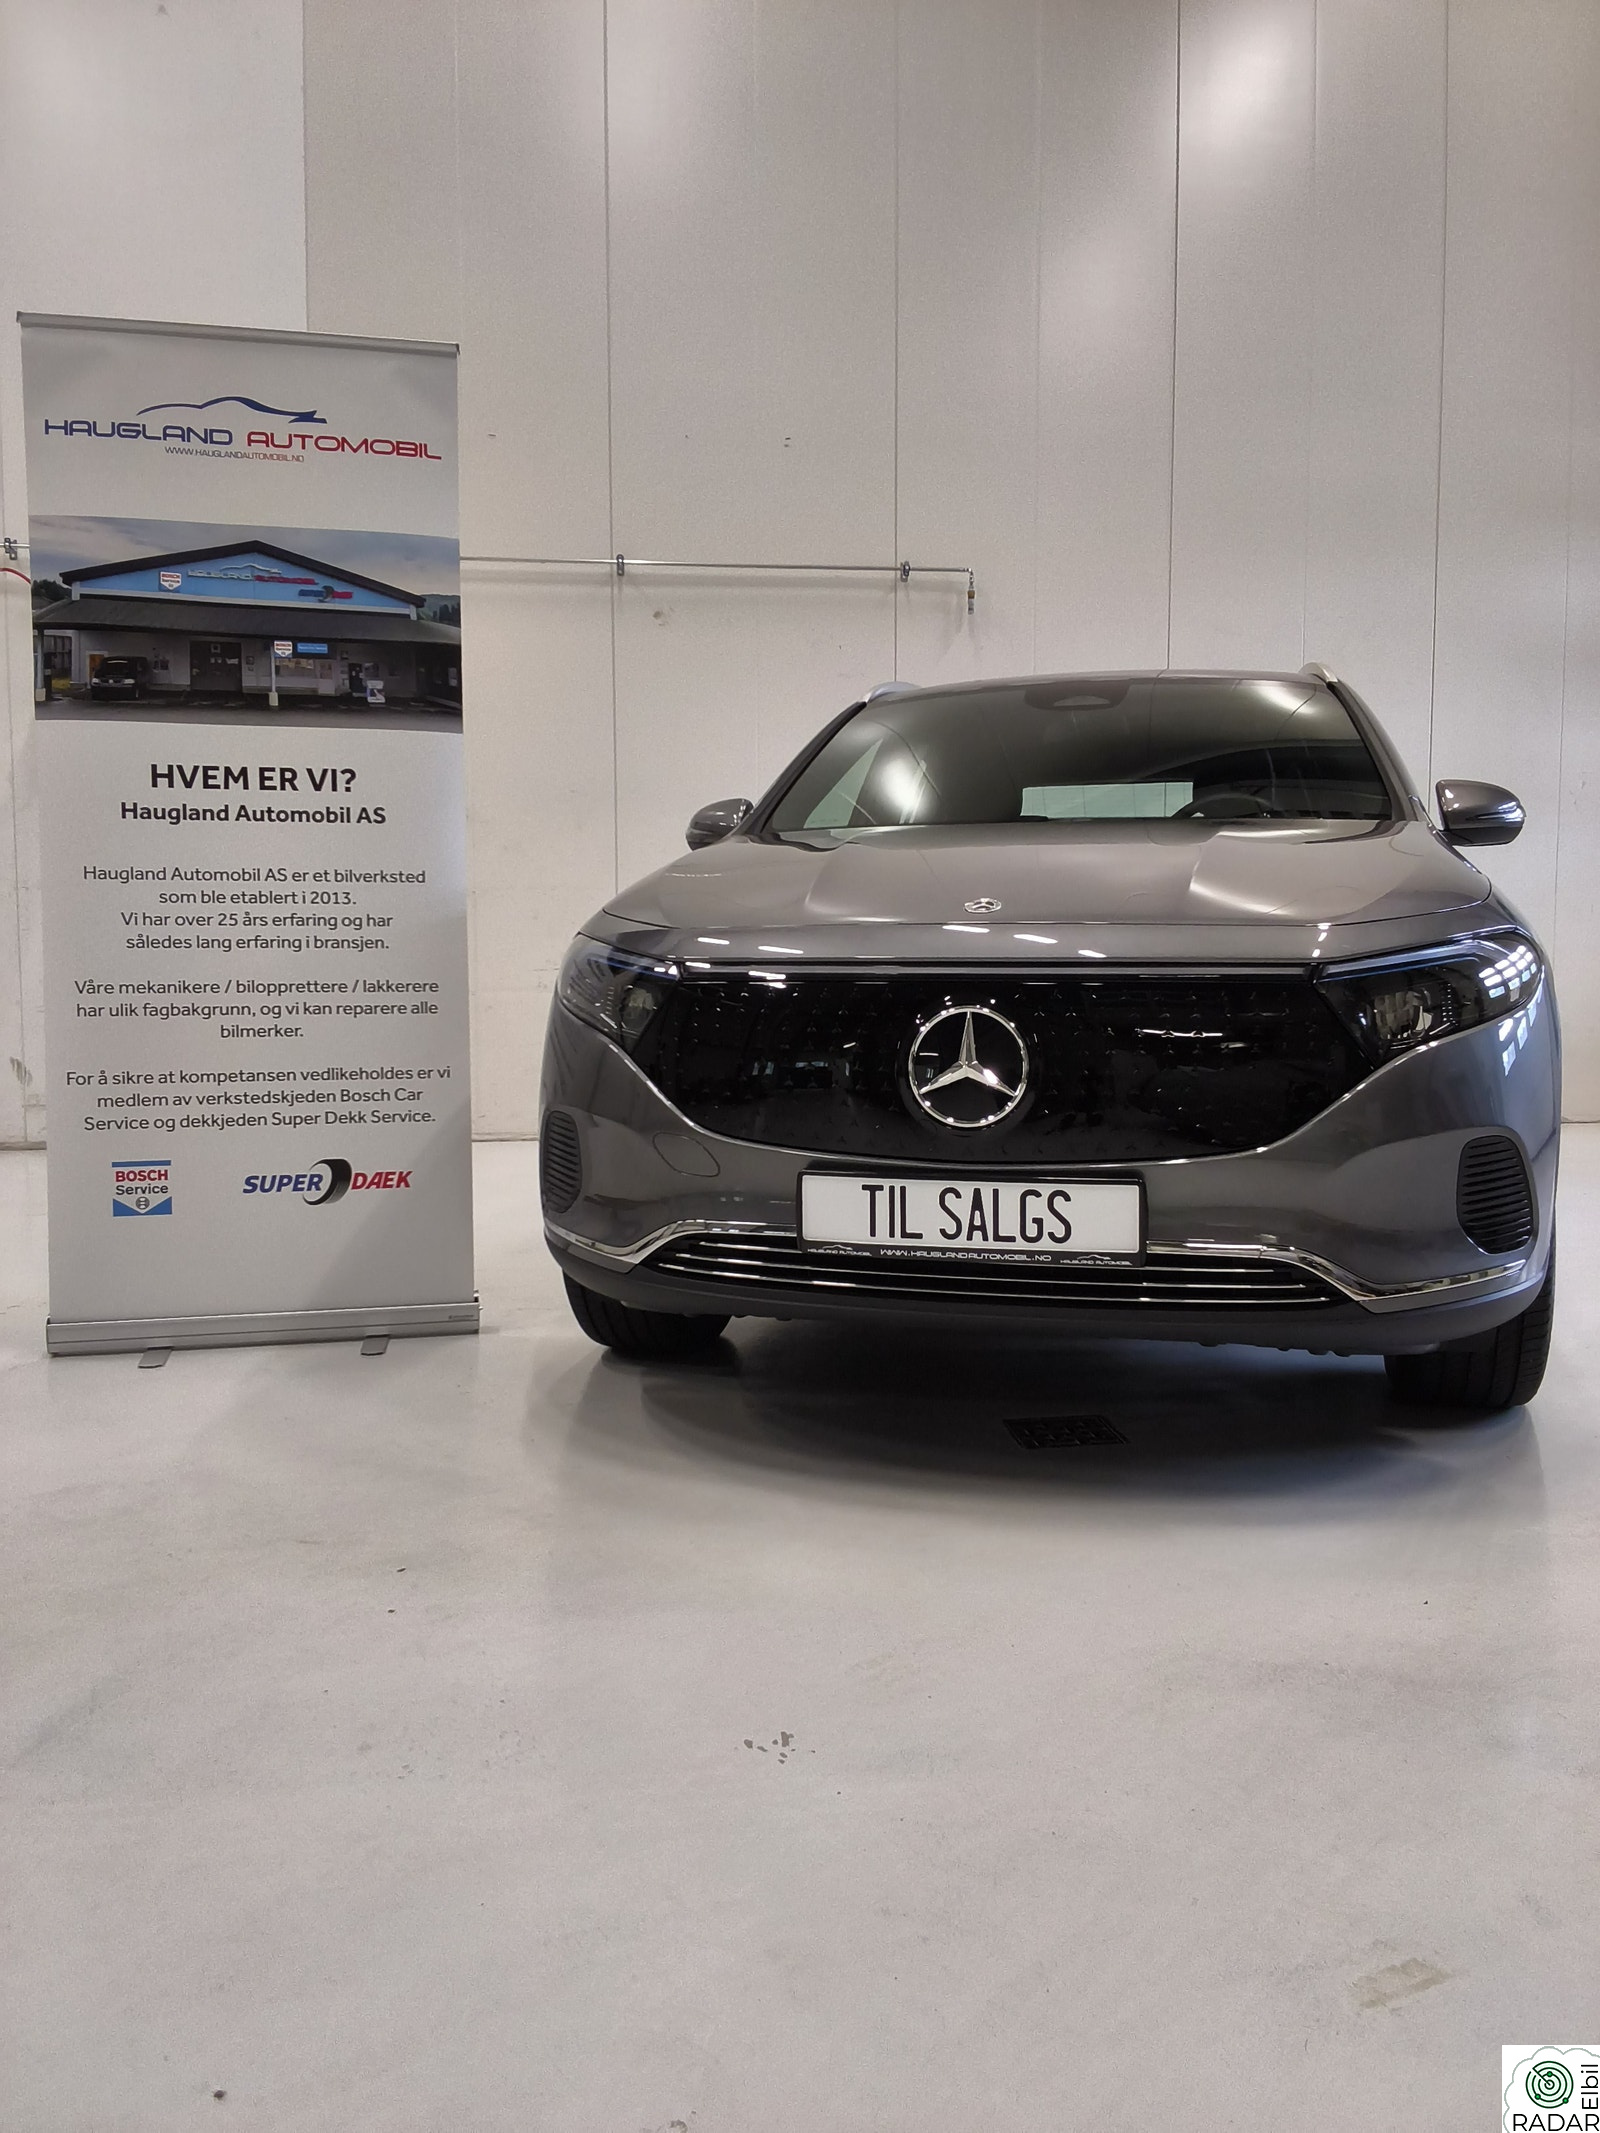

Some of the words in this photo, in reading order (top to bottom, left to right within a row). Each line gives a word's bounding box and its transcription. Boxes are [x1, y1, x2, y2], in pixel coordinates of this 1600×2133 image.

[44, 418, 233, 446] HAUGLAND
[246, 431, 443, 460] AUTOMOBIL
[164, 446, 305, 463] WWW.HAUGLANDAUTOMOBIL.NO
[150, 763, 250, 791] HVEM
[258, 766, 300, 792] ER
[305, 767, 357, 793] VI?
[120, 801, 230, 826] Haugland
[234, 804, 352, 824] Automobil
[355, 806, 387, 825] AS
[83, 865, 167, 885] Haugland
[170, 866, 261, 882] Automobil
[263, 867, 288, 883] AS
[291, 871, 310, 883] er
[312, 869, 332, 883] et
[333, 868, 426, 884] bilverksted
[158, 892, 197, 904] som
[200, 889, 227, 904] ble
[229, 889, 300, 905] etablert
[301, 890, 307, 905] i
[309, 890, 357, 906] 2013.
[120, 911, 139, 927] Vi
[142, 911, 172, 927] har
[174, 915, 215, 927] over
[217, 912, 239, 927] 25
[242, 910, 269, 927] års
[271, 912, 338, 931] erfaring
[340, 916, 363, 931] og
[366, 913, 394, 928] har
[125, 933, 193, 949] således
[196, 934, 232, 953] lang
[235, 934, 303, 953] erfaring
[305, 935, 311, 949] i
[313, 934, 390, 953] bransjen.
[73, 978, 115, 995] Våre
[118, 979, 221, 995] mekanikere
[235, 979, 349, 997] bilopprettere
[362, 979, 440, 993] lakkerere
[76, 1003, 106, 1018] har
[108, 1002, 140, 1017] ulik
[141, 1002, 257, 1021] fagbakgrunn,
[259, 1004, 282, 1020] og
[284, 1001, 300, 1016] vi
[302, 1001, 333, 1016] kan
[335, 1004, 408, 1019] reparere
[410, 1000, 439, 1015] alle
[220, 1023, 304, 1039] bilmerker.
[66, 1071, 95, 1086] For
[97, 1069, 108, 1086] å
[111, 1070, 155, 1085] sikre
[157, 1070, 177, 1085] at
[179, 1069, 297, 1087] kompetansen
[299, 1066, 414, 1082] vedlikeholdes
[416, 1069, 435, 1080] er
[436, 1065, 451, 1079] vi
[97, 1092, 169, 1108] medlem
[172, 1095, 193, 1107] av
[195, 1089, 337, 1107] verkstedskjeden
[340, 1088, 391, 1103] Bosch
[393, 1087, 424, 1102] Car
[83, 1116, 150, 1131] Service
[153, 1118, 176, 1133] og
[179, 1112, 268, 1131] dekkjeden
[271, 1111, 322, 1129] Super
[324, 1110, 368, 1125] Dekk
[370, 1109, 436, 1124] Service.
[115, 1169, 169, 1182] BOSCH
[242, 1173, 324, 1194] SUPER
[115, 1183, 169, 1195] Service
[861, 1184, 924, 1239] TIL
[938, 1186, 1072, 1244] SALGS
